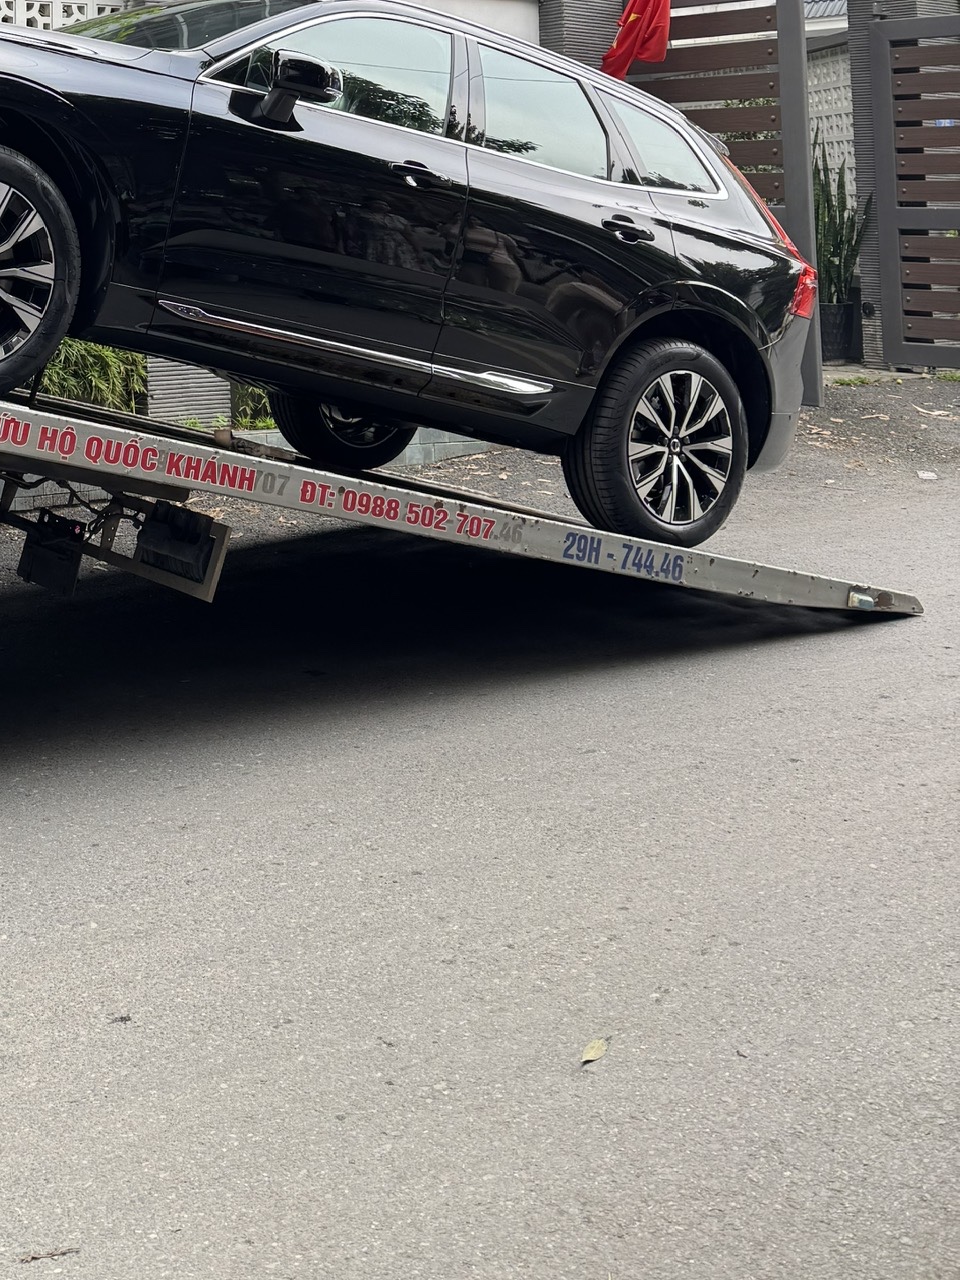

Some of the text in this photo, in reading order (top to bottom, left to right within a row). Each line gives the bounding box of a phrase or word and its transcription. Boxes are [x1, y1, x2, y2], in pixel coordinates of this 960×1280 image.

[37, 424, 78, 461] HỘ
[84, 434, 159, 472] QUỐC
[165, 451, 257, 493] KHÁNH
[299, 479, 336, 508] ĐT:
[342, 489, 400, 522] 0988
[405, 503, 449, 532] 502
[455, 512, 497, 540] 707
[563, 531, 602, 564] 29H
[621, 543, 685, 581] 744.46
